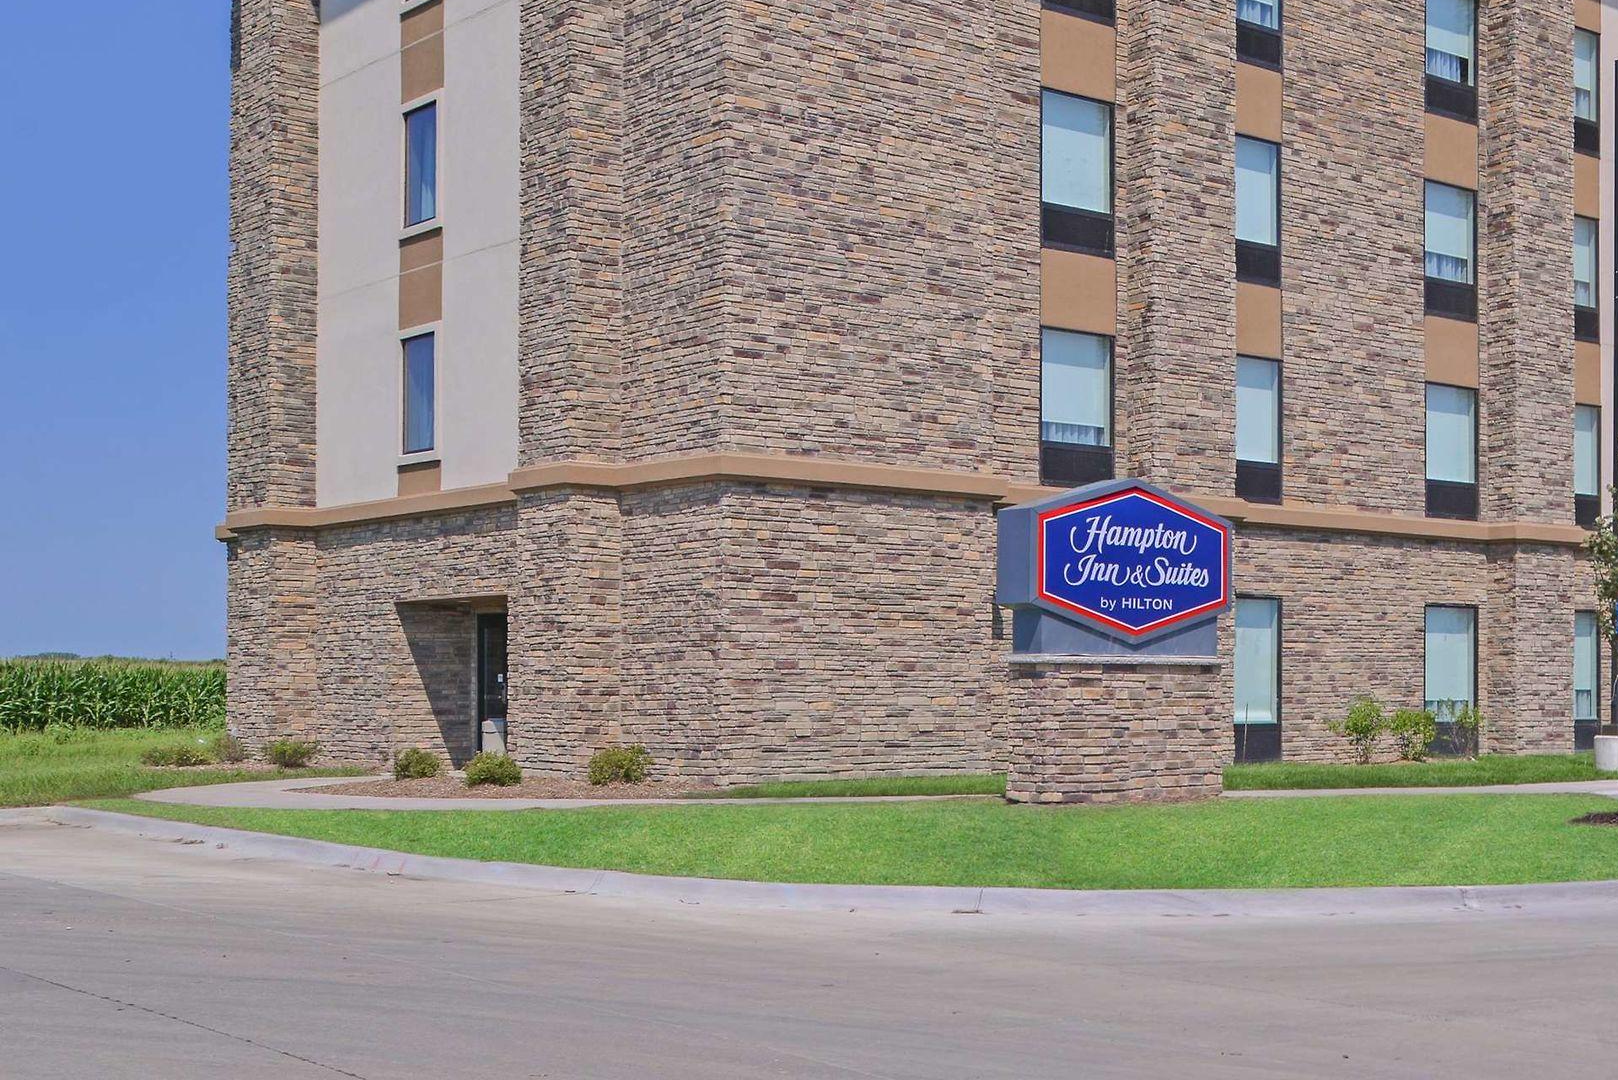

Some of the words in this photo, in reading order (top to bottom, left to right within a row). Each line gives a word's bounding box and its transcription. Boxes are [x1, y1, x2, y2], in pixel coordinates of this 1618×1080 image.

[1070, 515, 1197, 555] Hampton
[1064, 554, 1131, 586] Inn
[1130, 565, 1147, 588] &
[1145, 557, 1209, 588] Suites
[1100, 597, 1116, 611] by
[1122, 597, 1173, 610] HILTON
